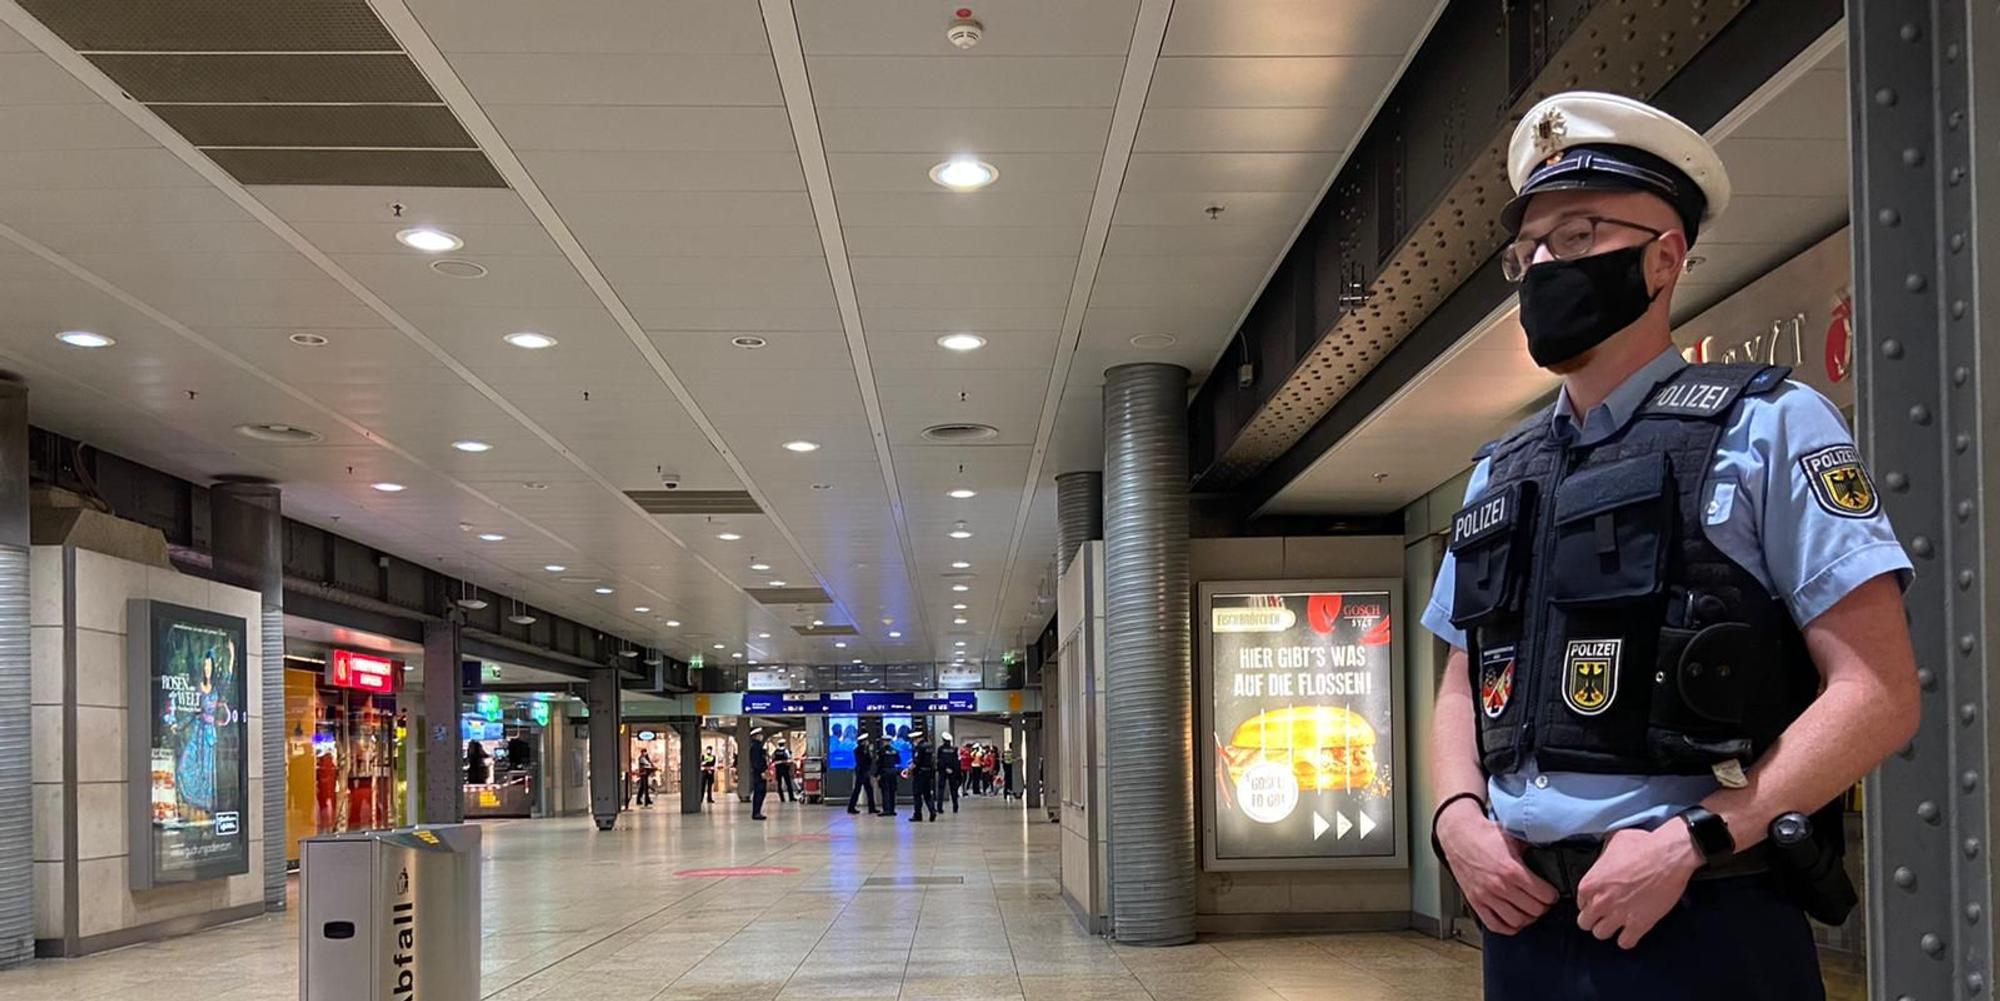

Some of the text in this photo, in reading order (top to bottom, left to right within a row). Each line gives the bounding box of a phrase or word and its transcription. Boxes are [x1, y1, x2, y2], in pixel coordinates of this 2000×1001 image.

[1810, 450, 1859, 472] POLIZEI
[1454, 496, 1506, 542] POLIZEI
[1343, 604, 1381, 616] GOSCH
[1239, 647, 1273, 669] HIER
[1330, 645, 1366, 668] WAS
[1570, 643, 1616, 657] POLIZEI
[1233, 671, 1372, 697] AUF DIE FLOSSEN!
[177, 691, 201, 706] WELT
